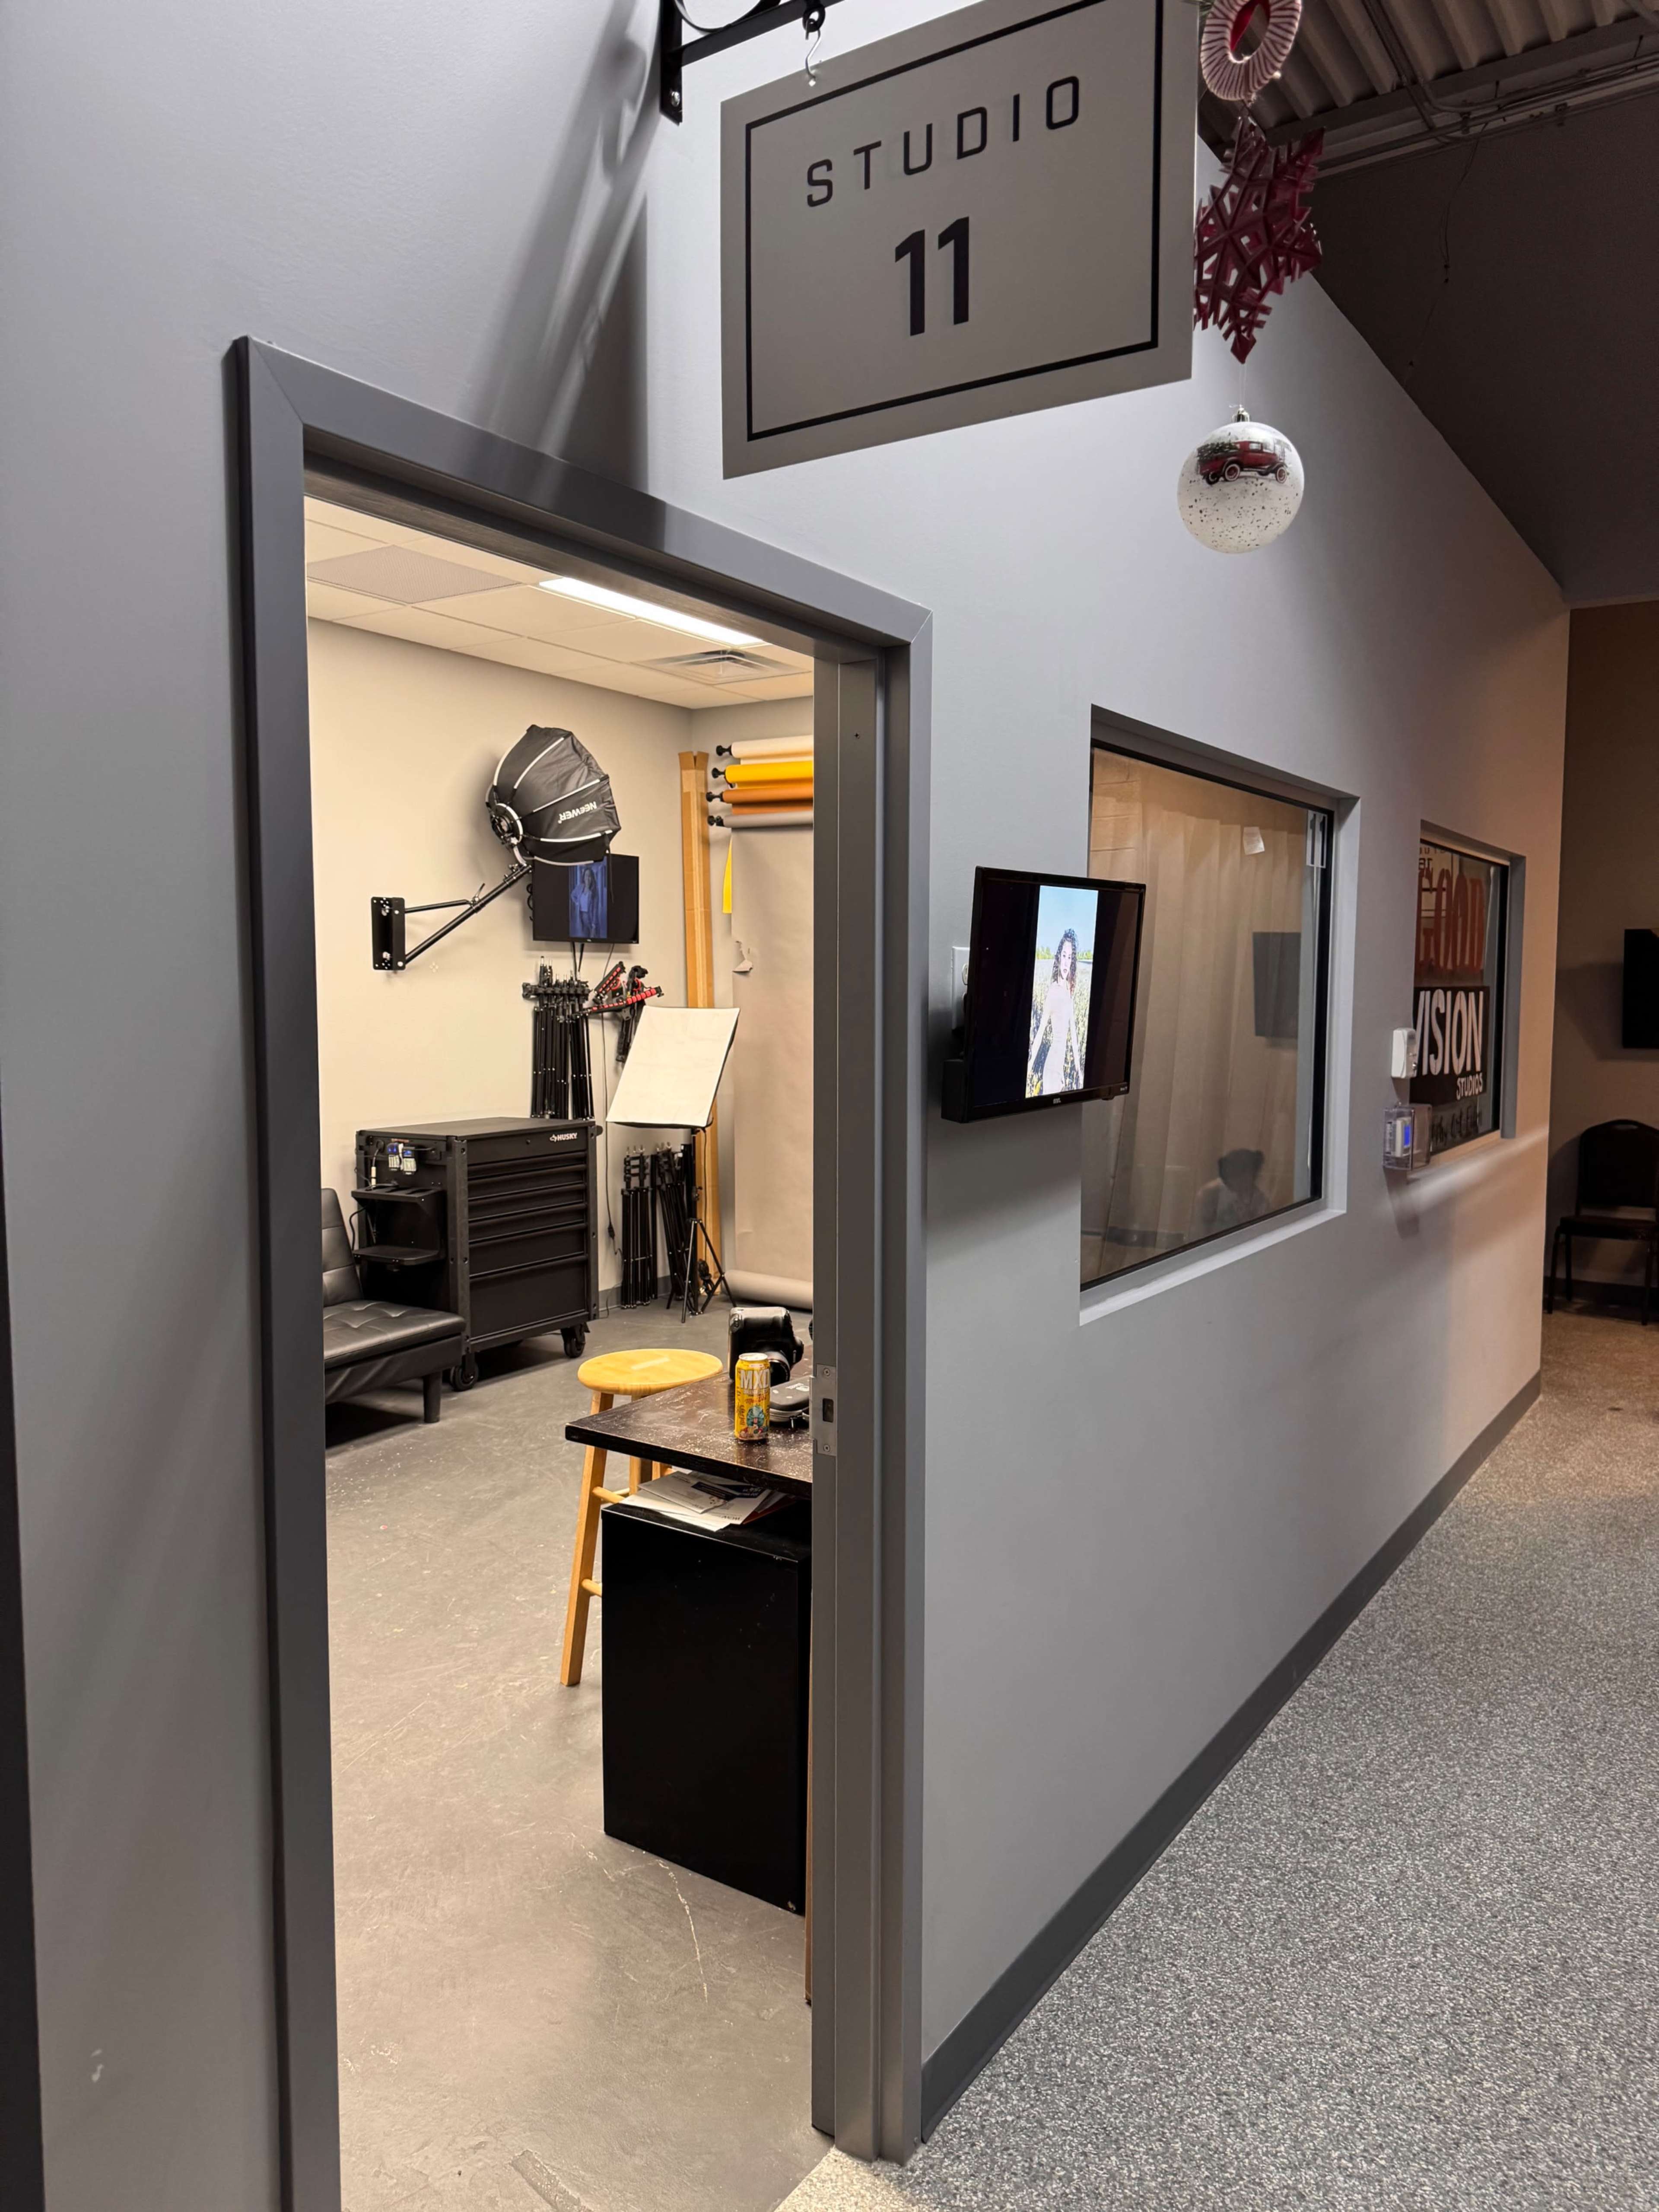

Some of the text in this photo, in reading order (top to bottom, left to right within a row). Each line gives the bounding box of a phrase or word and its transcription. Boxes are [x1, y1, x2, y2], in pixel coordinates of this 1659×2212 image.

[806, 75, 1080, 207] STUDIO
[894, 216, 969, 336] 11
[1456, 1073, 1483, 1100] STUDIOS
[557, 1132, 578, 1141] HUSKY
